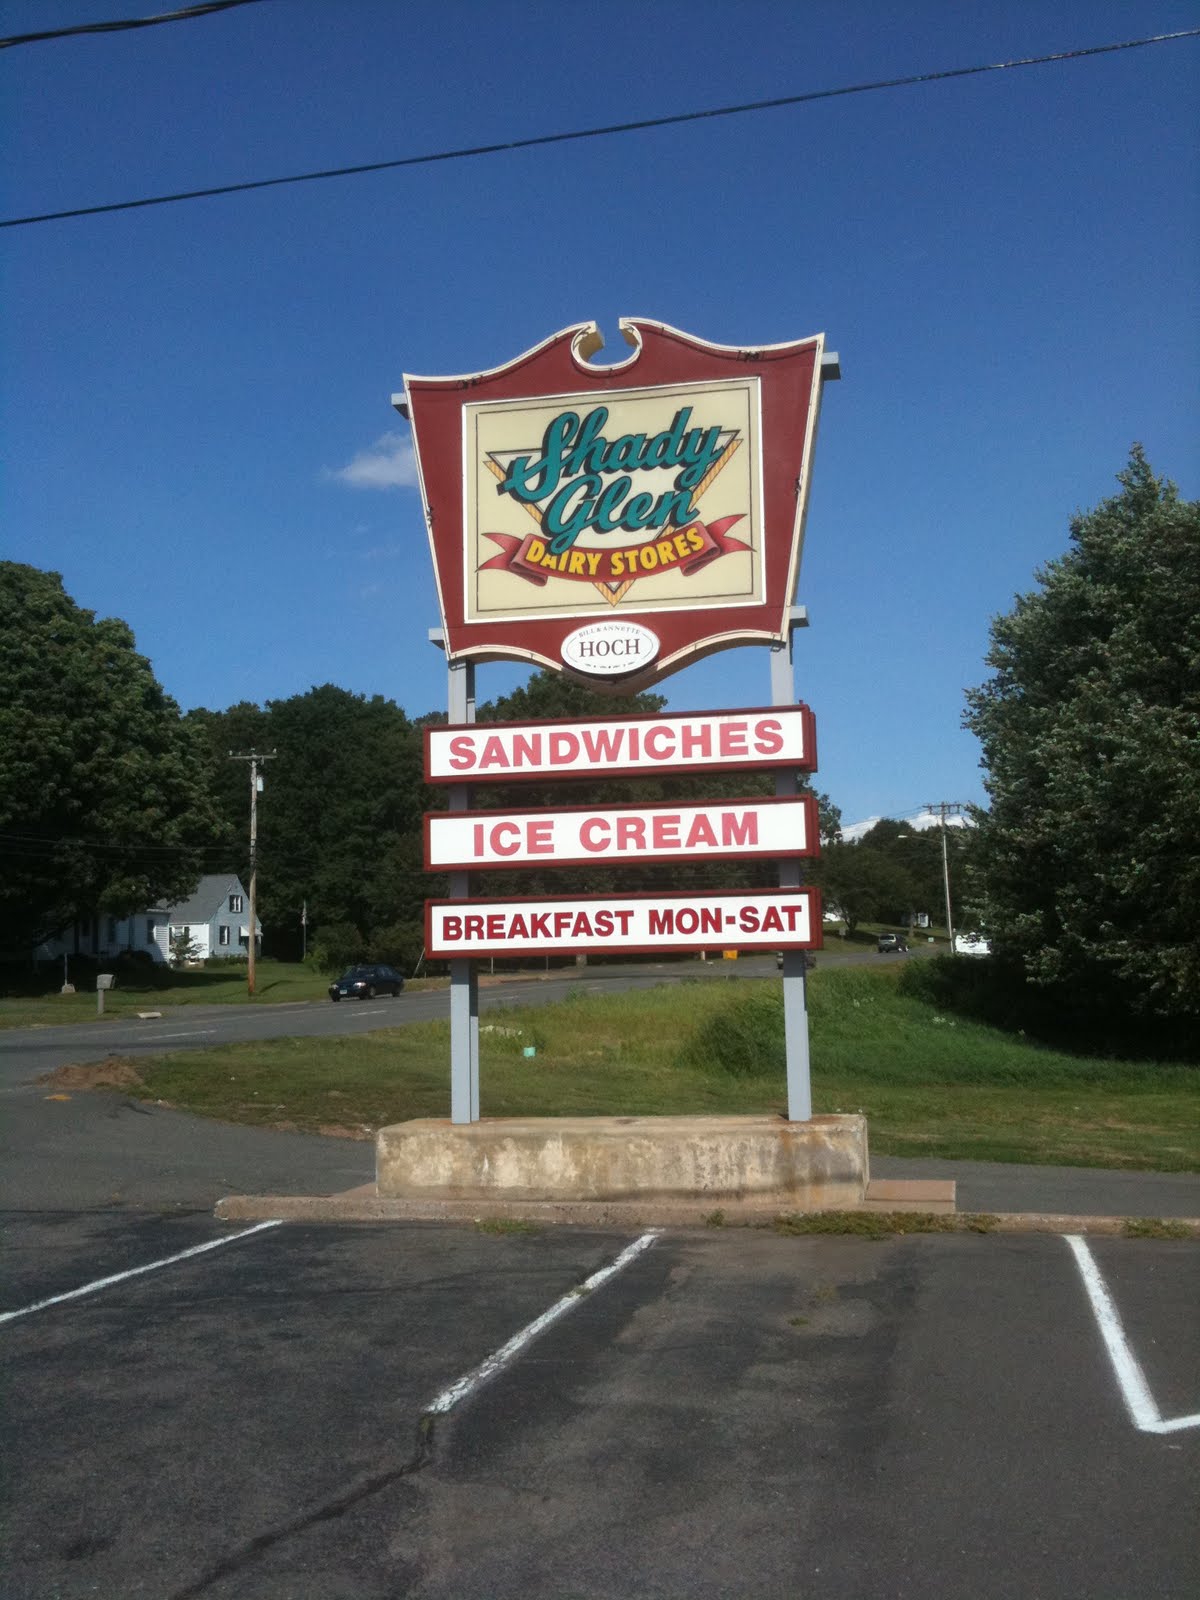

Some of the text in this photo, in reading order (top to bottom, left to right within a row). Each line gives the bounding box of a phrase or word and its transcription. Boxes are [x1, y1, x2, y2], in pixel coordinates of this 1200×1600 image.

[496, 406, 725, 503] Shady
[541, 474, 700, 555] Glen
[610, 528, 705, 576] STORES
[579, 638, 640, 658] HOCH
[448, 719, 785, 770] SANDWICHES
[473, 811, 759, 857] ICE CREAM
[442, 905, 802, 941] BREAKFAST MON-SAT
